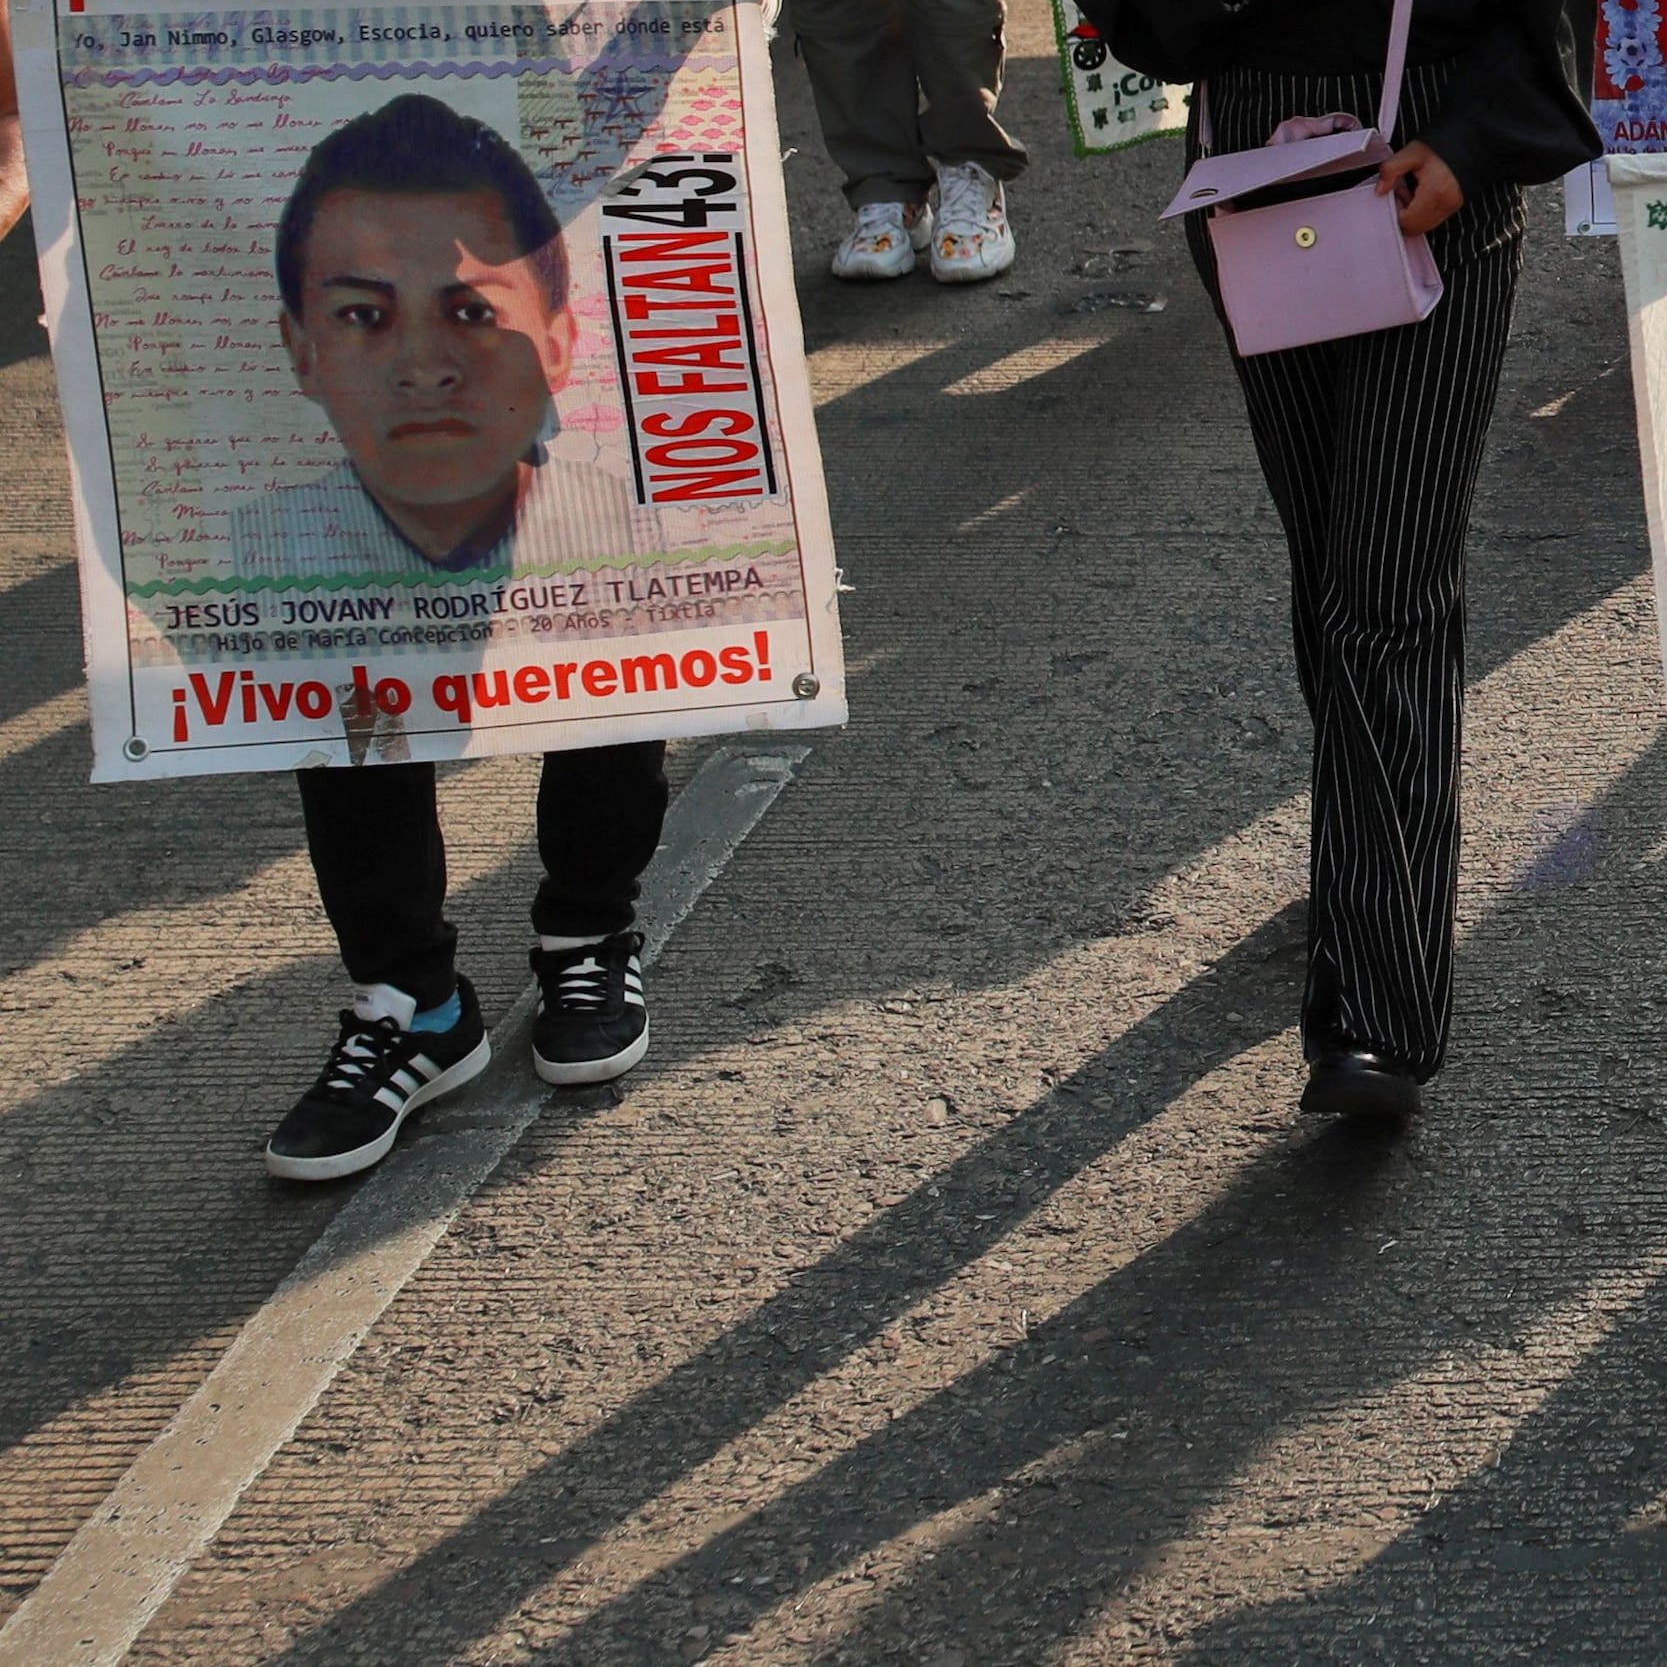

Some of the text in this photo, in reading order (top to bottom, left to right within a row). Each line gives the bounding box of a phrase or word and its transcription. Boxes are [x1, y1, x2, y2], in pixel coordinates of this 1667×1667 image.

[166, 15, 726, 52] Nimmo, Glasgow, Escocia, quiero saber dónde está
[618, 231, 749, 396] FALTAN
[640, 408, 764, 503] NOS
[166, 565, 765, 631] JESÚS JOVANY RODRÍGUEZ TLATEMPA
[171, 629, 774, 744] ¡Vivo queremos!
